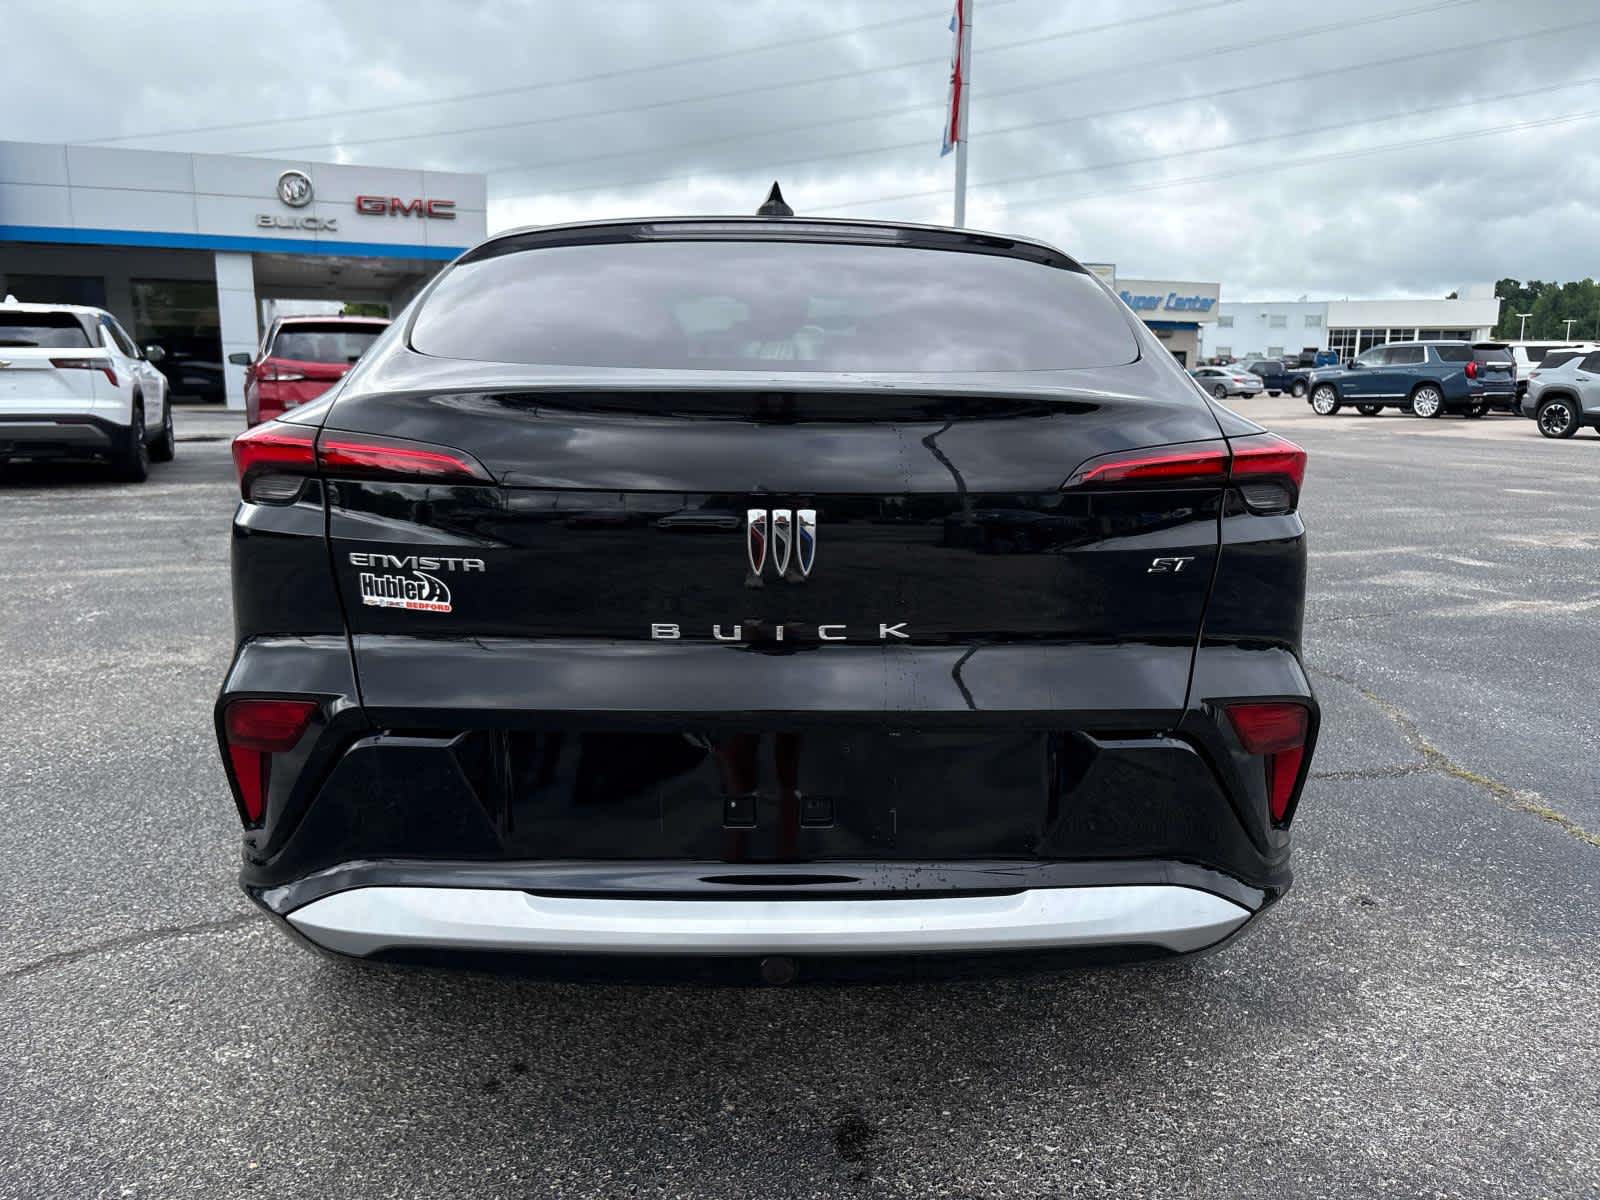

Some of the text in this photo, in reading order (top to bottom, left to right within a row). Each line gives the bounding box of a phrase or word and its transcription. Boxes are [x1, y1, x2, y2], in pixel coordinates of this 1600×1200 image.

[356, 195, 456, 219] GMC
[256, 214, 338, 232] BUICK
[1120, 290, 1217, 312] Super Center
[349, 552, 486, 572] ENVISTA
[360, 572, 427, 601] Hubler
[405, 601, 451, 612] BEDFORD
[651, 622, 910, 641] BUICK
